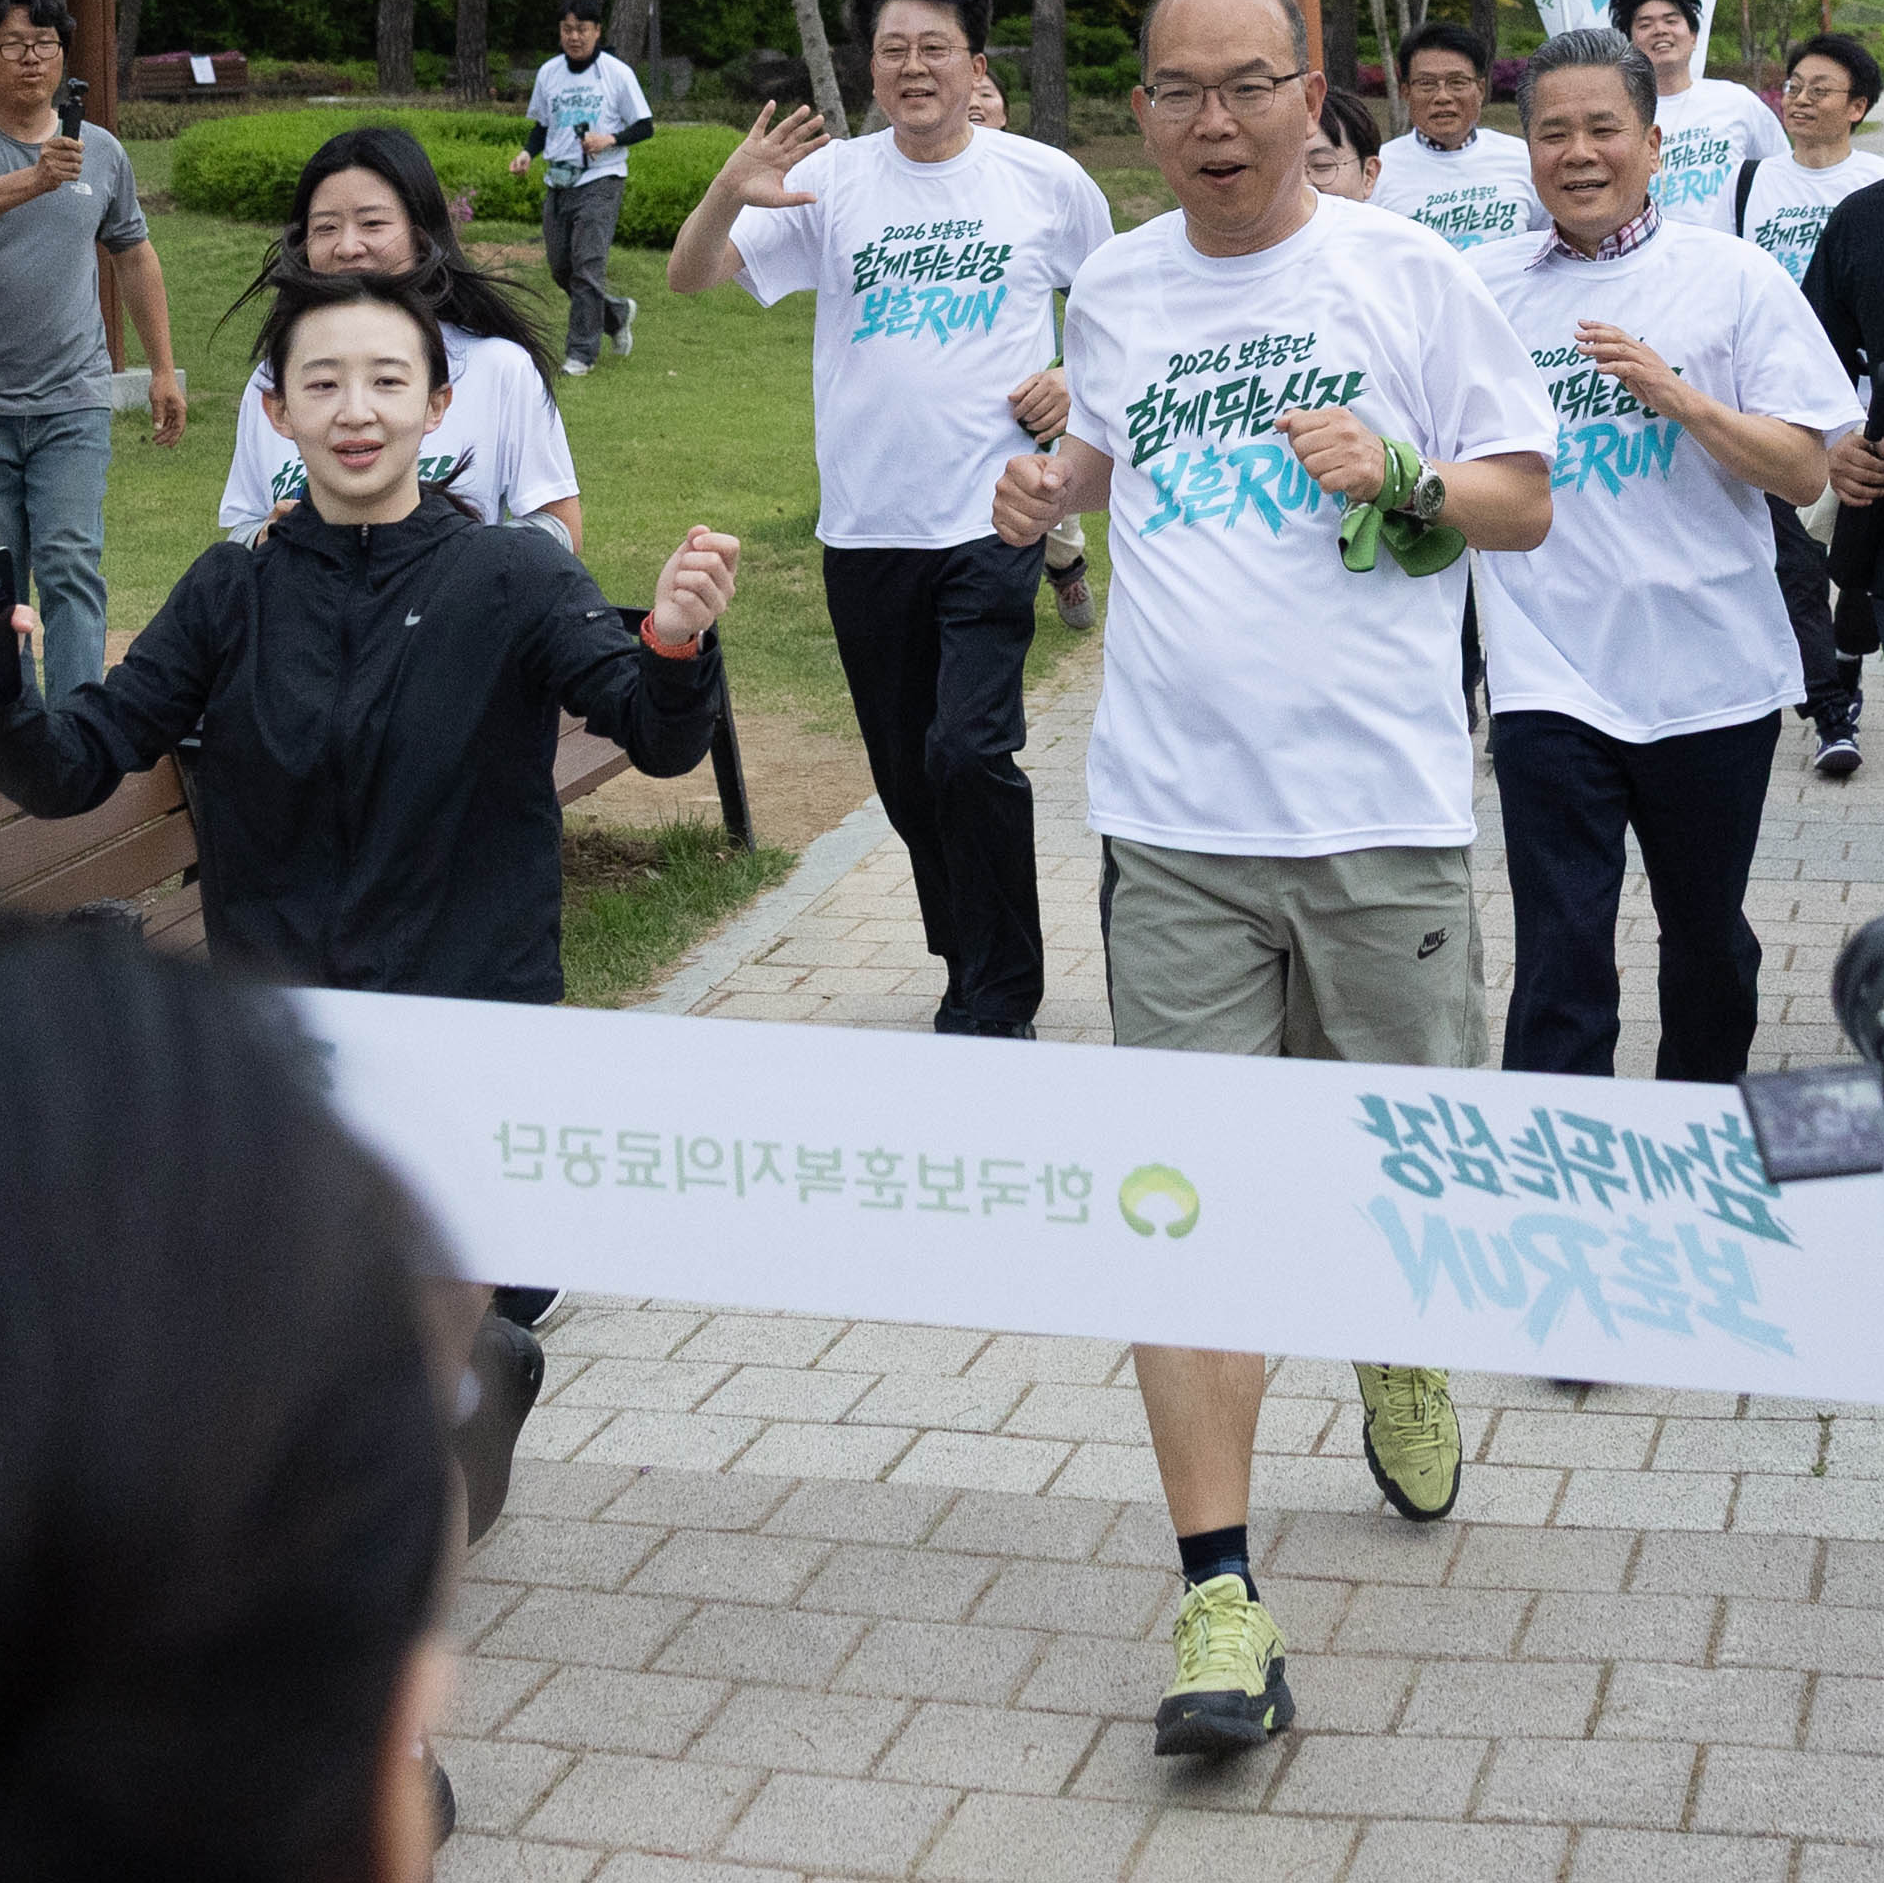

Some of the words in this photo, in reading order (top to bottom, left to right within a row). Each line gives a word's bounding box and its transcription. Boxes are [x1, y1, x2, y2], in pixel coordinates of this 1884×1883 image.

[1426, 190, 1458, 208] 2026
[1460, 185, 1498, 201] 보훈공단
[1776, 205, 1808, 220] 2026
[881, 222, 926, 244] 2026
[928, 219, 984, 240] 보훈공단
[1166, 343, 1230, 383] 2026
[1235, 332, 1316, 372] 보훈공단
[1531, 342, 1580, 368] 2026
[1422, 927, 1446, 948] NIKE
